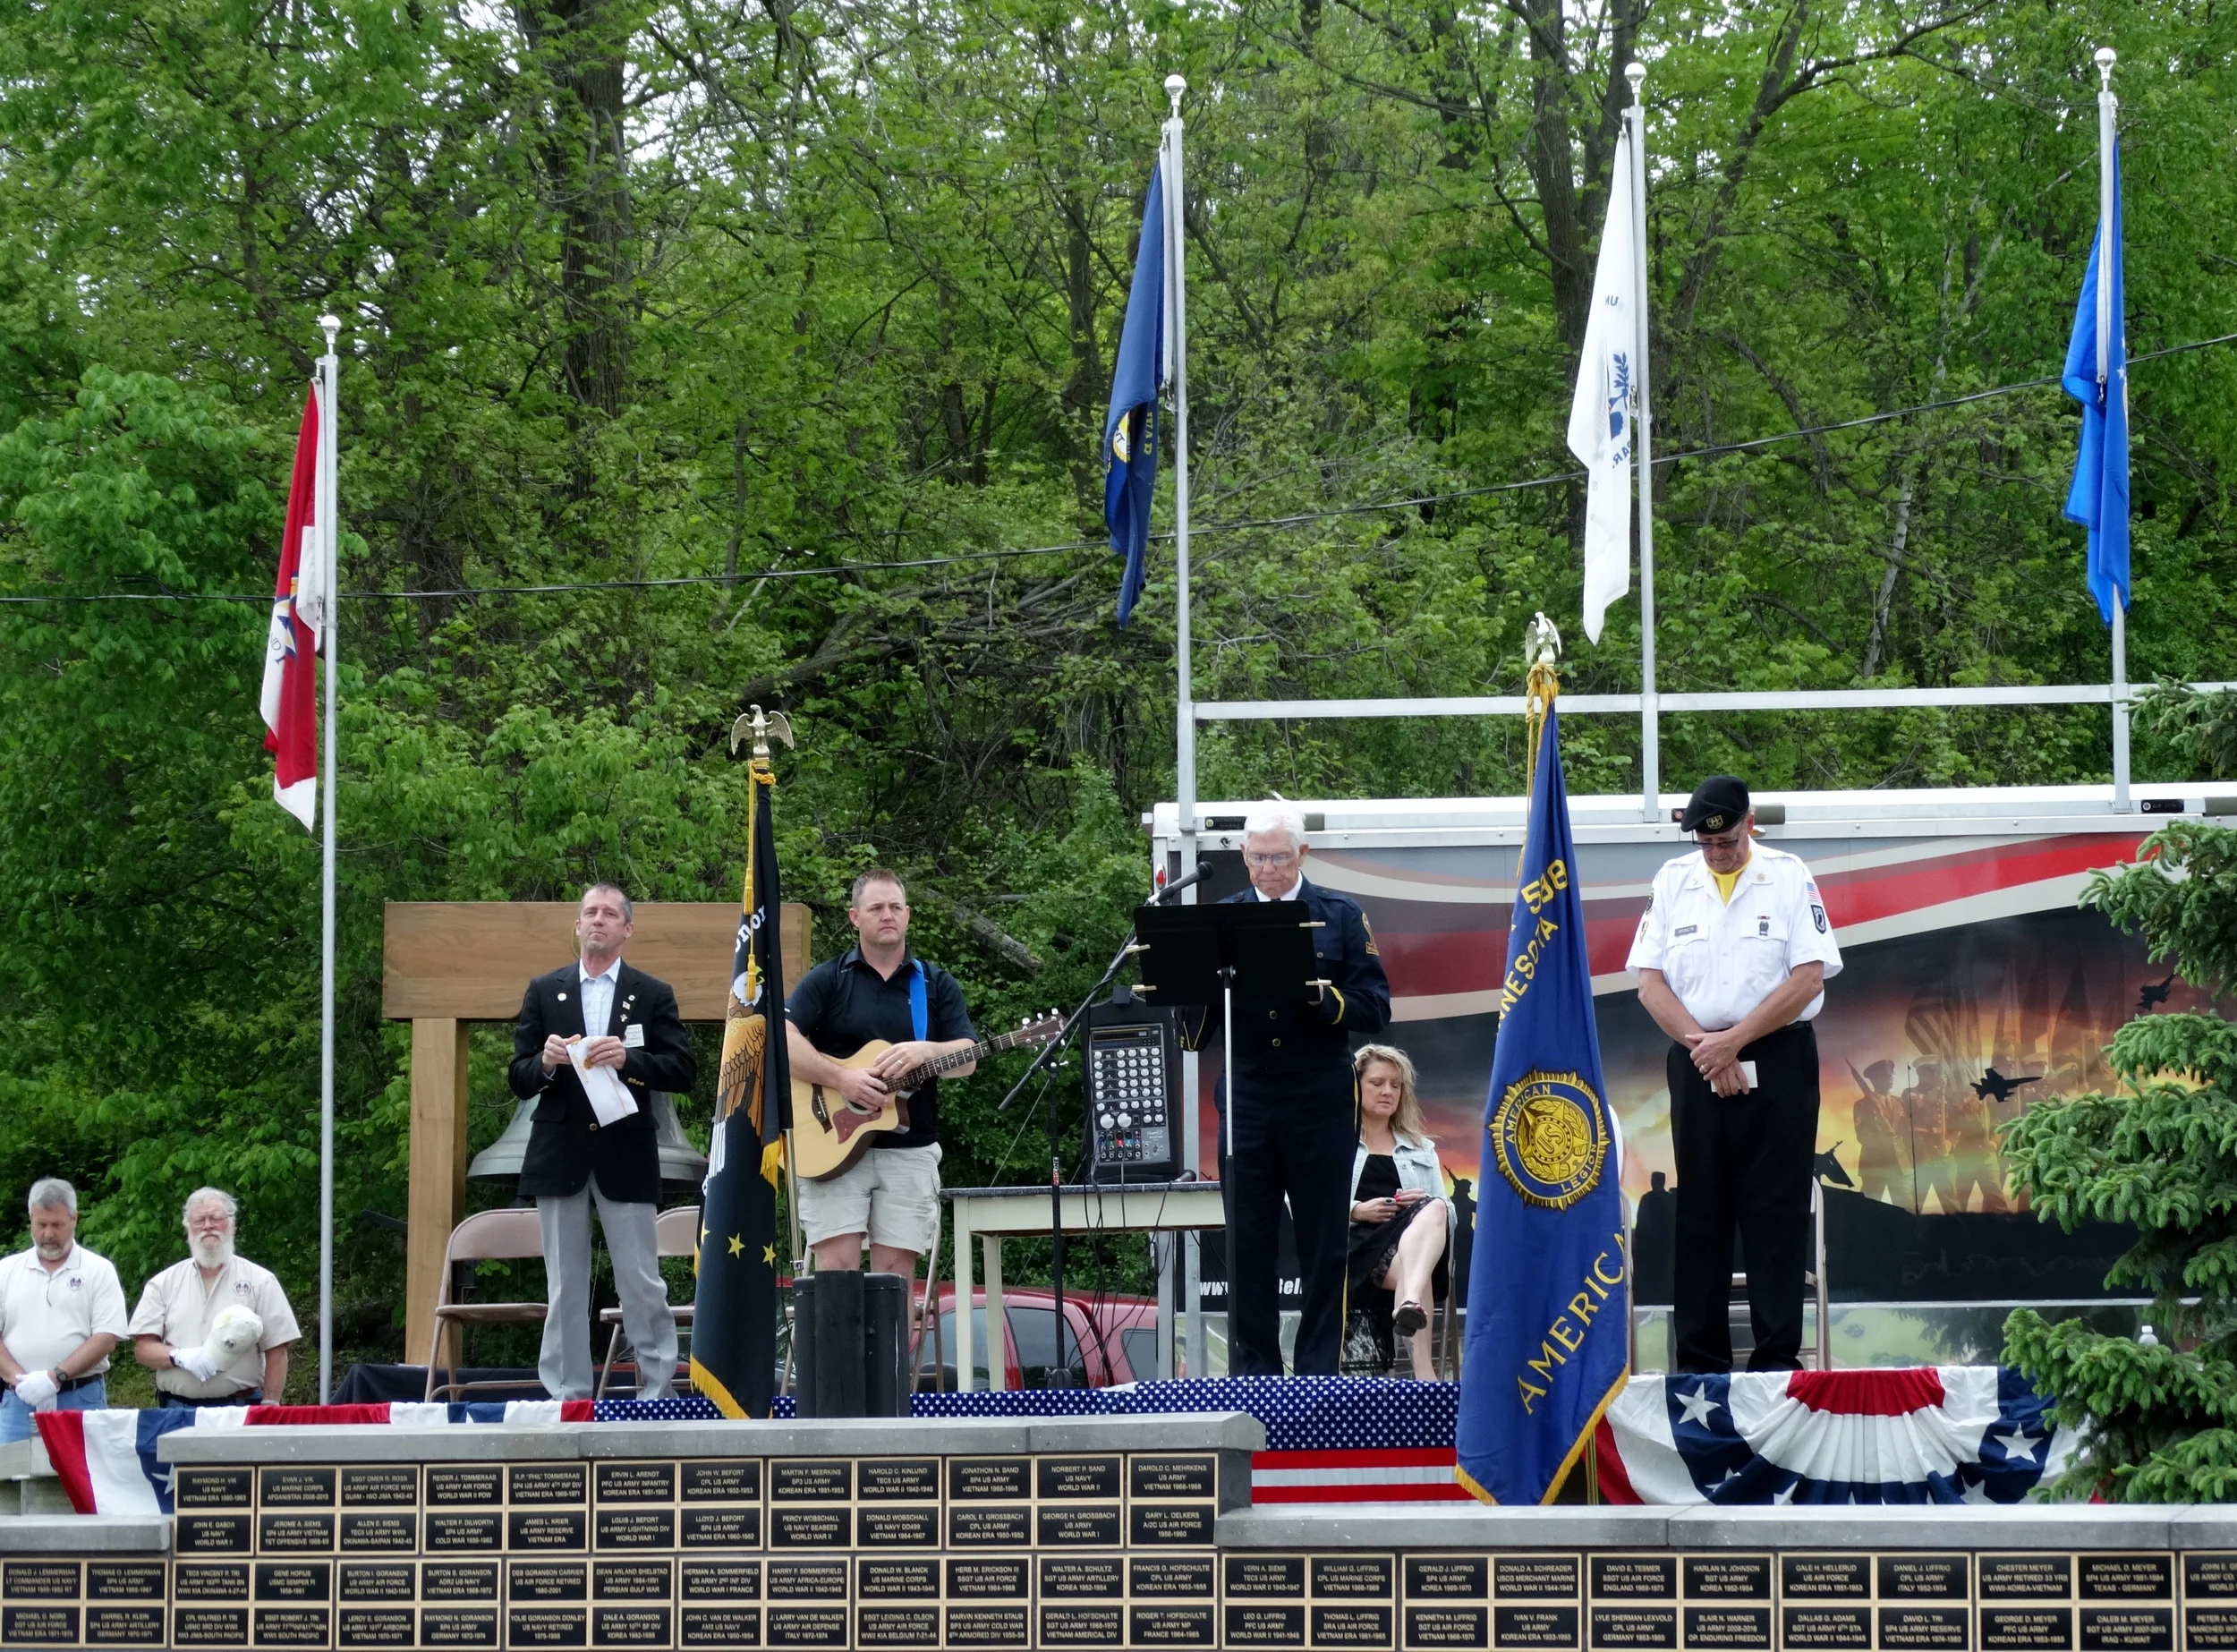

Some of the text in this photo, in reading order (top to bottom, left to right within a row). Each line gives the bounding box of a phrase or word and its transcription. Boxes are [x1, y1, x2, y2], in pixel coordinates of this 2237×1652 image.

[1505, 1084, 1551, 1145] AMERICAN
[1561, 1143, 1597, 1194] LEGION
[721, 1469, 744, 1477] BEFORT
[1051, 1465, 1081, 1473] NORBERT
[191, 1477, 220, 1485] RAYMOND
[432, 1474, 454, 1482] REIDER
[722, 1477, 740, 1486] ARMY
[970, 1476, 982, 1484] SP4
[623, 1479, 640, 1487] ARMY
[202, 1486, 210, 1494] US
[303, 1484, 324, 1492] CORPS
[628, 1488, 641, 1496] ERA
[478, 1491, 492, 1499] POW
[803, 1514, 839, 1522] WOBSCHALL
[892, 1513, 929, 1521] WOBSCHALL
[1077, 1511, 1116, 1520] GROSSBACH
[627, 1525, 659, 1533] LIGHTNING
[811, 1523, 838, 1531] SEABEES
[969, 1522, 982, 1530] CPL
[982, 1522, 991, 1530] US
[1064, 1521, 1074, 1529] US
[520, 1527, 529, 1535] US
[529, 1527, 546, 1535] ARMY
[1058, 1530, 1081, 1538] WORLD
[1082, 1530, 1096, 1538] WAR
[194, 1538, 215, 1546] WORLD
[215, 1538, 228, 1546] WAR
[616, 1534, 637, 1542] WORLD
[638, 1534, 652, 1542] WAR
[904, 1566, 928, 1574] BLANCK
[981, 1565, 1013, 1573] ERICKSON
[1051, 1565, 1076, 1573] WALTER
[1243, 1564, 1260, 1572] VERN
[1268, 1564, 1287, 1572] SIEMS
[1996, 1563, 2054, 1572] CHESTER MEYER
[2092, 1563, 2122, 1571] MICHAEL
[2131, 1563, 2156, 1571] MEYER
[906, 1575, 927, 1583] CORPS
[1982, 1574, 1992, 1582] US
[1993, 1574, 2012, 1582] ARMY
[2013, 1574, 2044, 1582] RETIRED
[2054, 1573, 2068, 1582] YRS
[515, 1578, 523, 1586] US
[524, 1578, 534, 1586] AIR
[535, 1578, 555, 1586] FORCE
[1514, 1614, 1528, 1622] IVAN
[1536, 1614, 1558, 1622] FRANK
[1903, 1614, 1924, 1622] DAVID
[1932, 1614, 1943, 1622] TRI
[1521, 1623, 1550, 1631] US ARMY
[1899, 1624, 1909, 1633] US
[1910, 1624, 1929, 1633] ARMY
[1930, 1624, 1961, 1632] RESERVE
